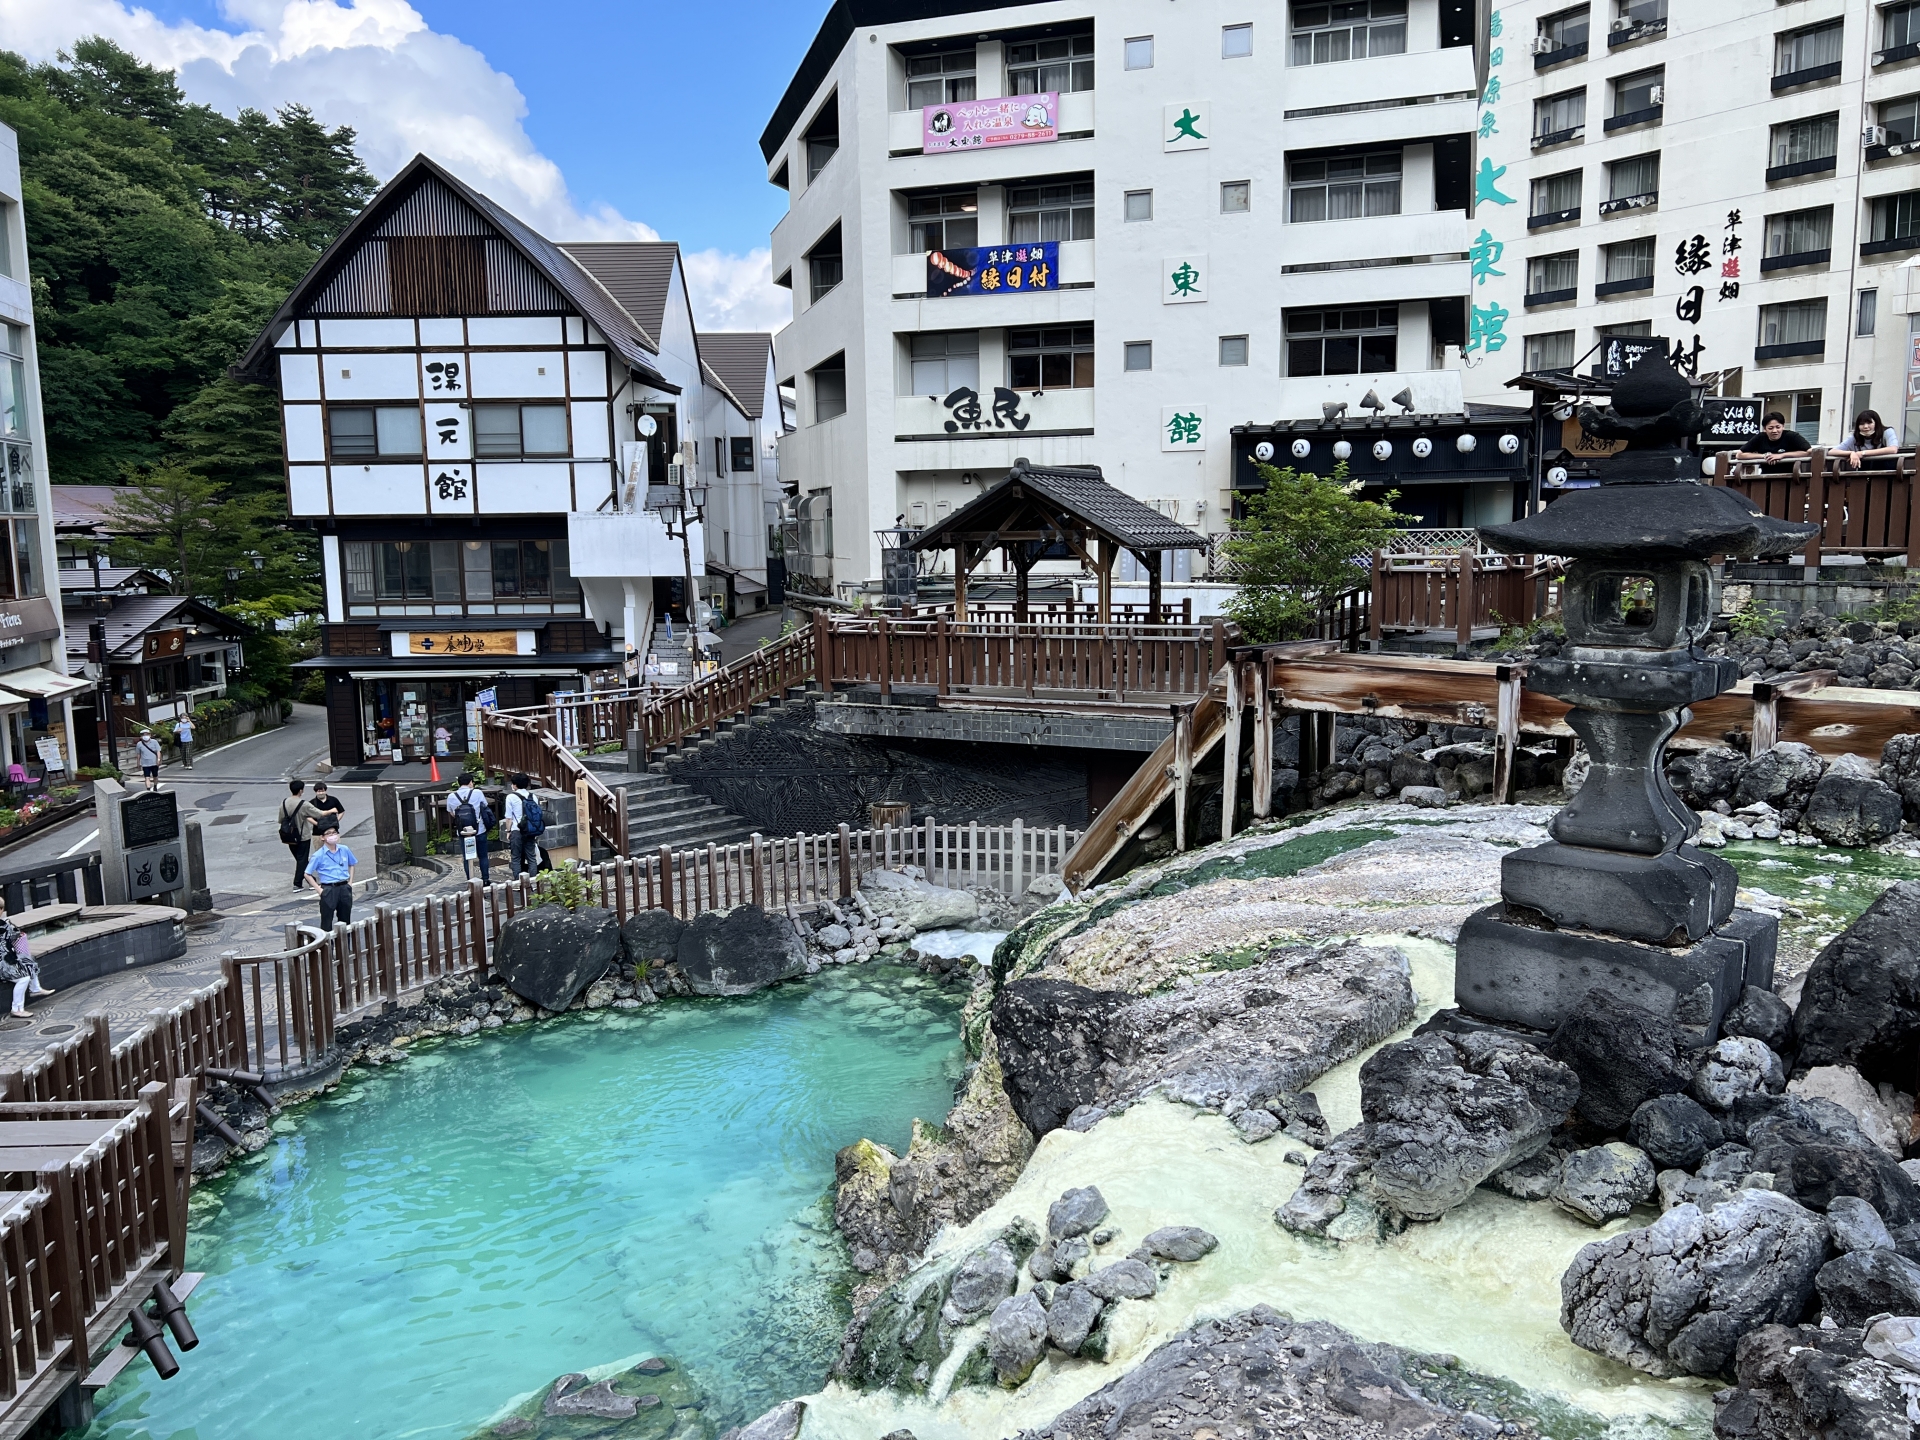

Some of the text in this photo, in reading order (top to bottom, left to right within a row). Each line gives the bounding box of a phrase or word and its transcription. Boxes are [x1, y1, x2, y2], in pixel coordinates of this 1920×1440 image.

[958, 103, 1019, 117] ペットと一緒に
[964, 117, 1013, 131] 入れる温泉
[948, 136, 982, 148] 大東館
[981, 263, 1050, 290] 縁日村
[1164, 108, 1208, 443] 大東館
[1465, 157, 1517, 353] 大東館
[1669, 234, 1712, 378] 縁日村
[425, 362, 467, 500] 湯元館
[943, 387, 1031, 433] 魚民
